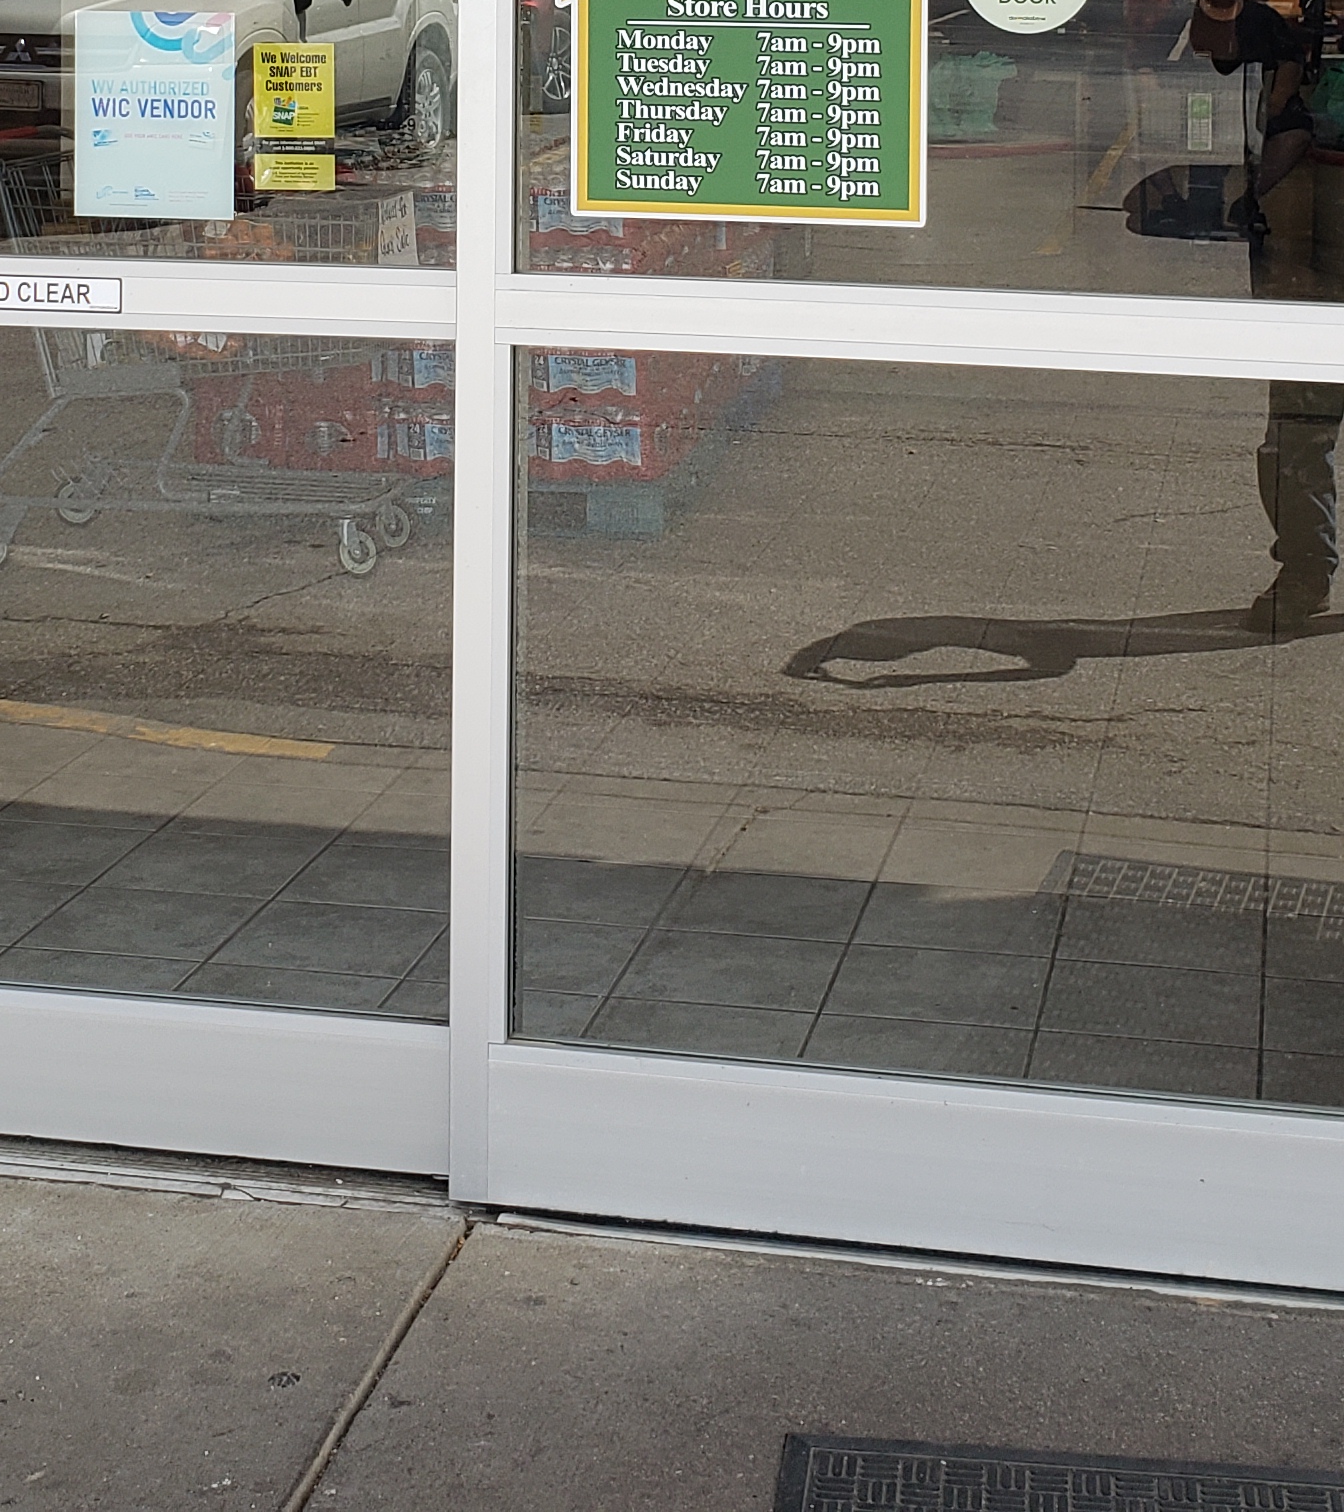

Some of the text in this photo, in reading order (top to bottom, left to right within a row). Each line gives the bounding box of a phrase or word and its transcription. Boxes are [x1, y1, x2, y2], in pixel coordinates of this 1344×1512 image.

[616, 29, 714, 55] Monday
[756, 32, 808, 53] 7am
[827, 33, 882, 59] 9pm
[261, 52, 327, 64] We Welcome
[616, 52, 711, 78] Tuesday
[756, 56, 808, 77] 7am
[827, 57, 882, 83] 9pm
[269, 66, 319, 78] SNAP EBT
[92, 79, 210, 96] WV AUTHORIZED
[265, 80, 322, 92] Customers
[616, 76, 748, 103] Wednesday
[756, 79, 808, 100] 7am
[827, 80, 882, 106] 9pm
[91, 97, 216, 119] WIC VENDOR
[273, 111, 296, 121] SNAP
[616, 99, 728, 126] Thursday
[756, 103, 808, 124] 7am
[826, 104, 881, 130] 9pm
[616, 122, 694, 148] Friday
[756, 126, 808, 147] 7am
[826, 127, 881, 153] 9pm
[616, 145, 722, 172] Saturday
[756, 150, 808, 171] 7am
[826, 151, 881, 177] 9pm
[616, 168, 703, 195] Sunday
[755, 174, 807, 195] 7am
[825, 175, 880, 201] 9pm
[18, 282, 91, 304] CLEAR
[409, 424, 420, 434] 24
